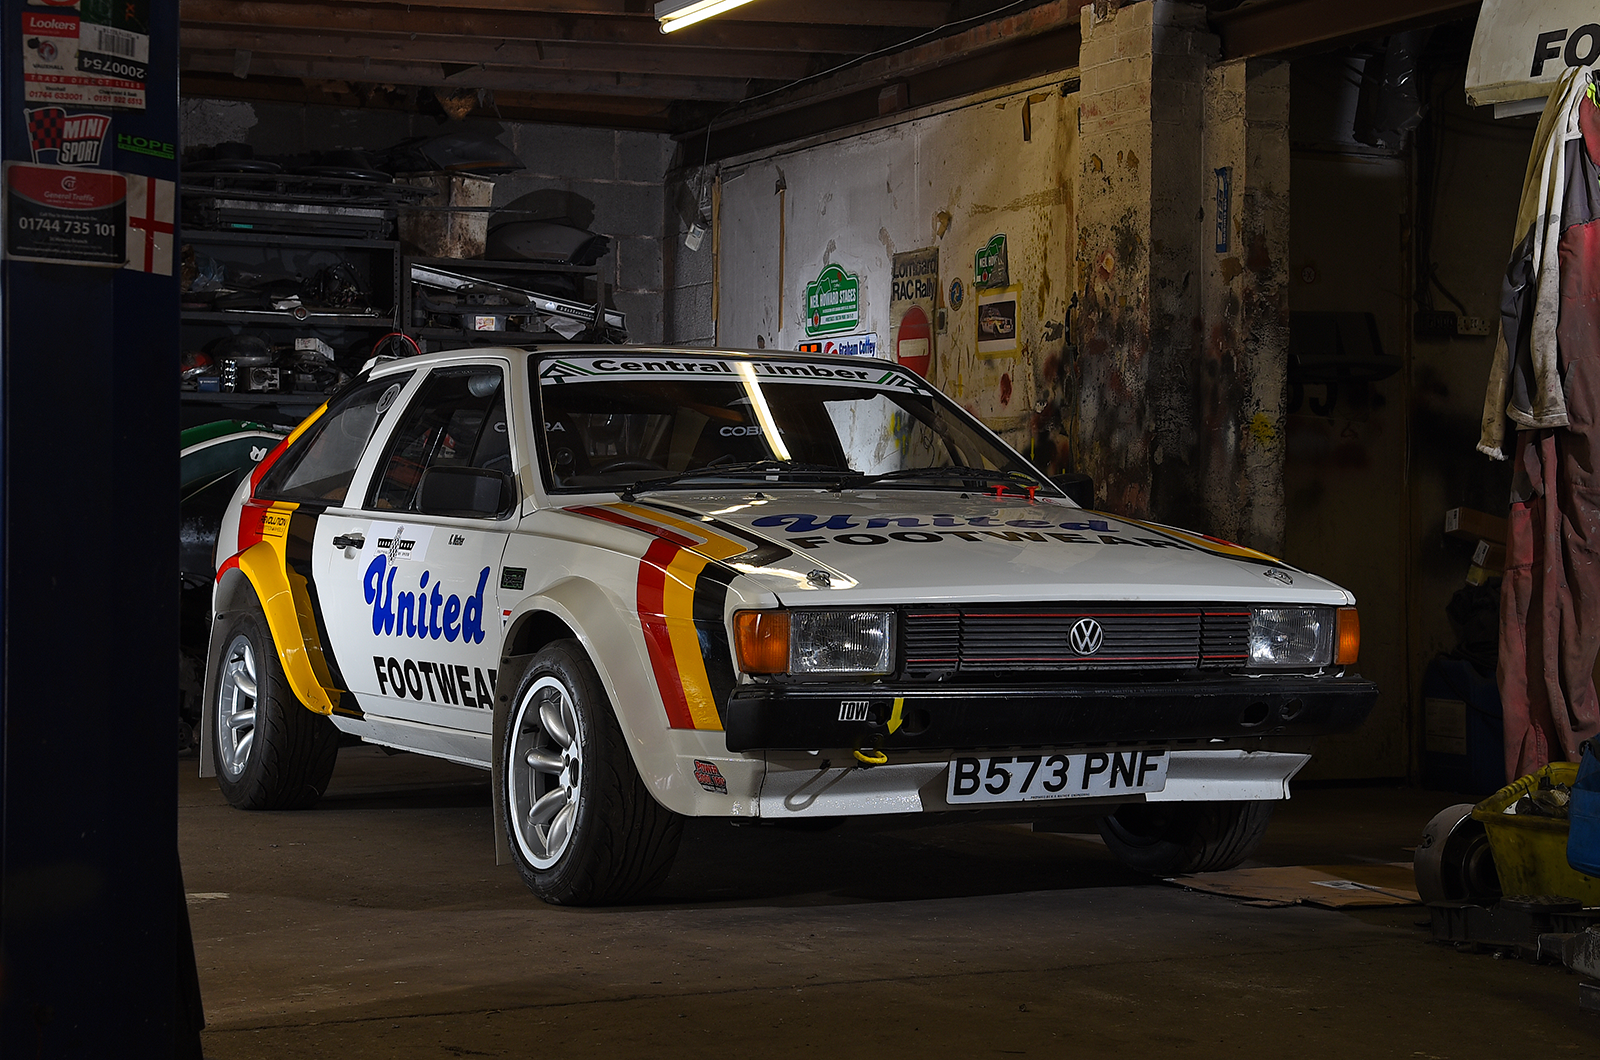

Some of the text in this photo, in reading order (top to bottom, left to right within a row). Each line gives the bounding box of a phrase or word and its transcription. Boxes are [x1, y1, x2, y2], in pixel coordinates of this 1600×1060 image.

[29, 16, 77, 31] Lookers
[30, 74, 141, 89] TRADE DIRECT LINES
[29, 91, 83, 100] 01744 633001
[63, 118, 105, 139] MINI
[60, 140, 100, 163] SPORT
[117, 133, 175, 153] HOPE
[44, 191, 95, 202] General Traffic
[18, 216, 117, 237] 01744 735 101
[892, 256, 937, 280] Lombard
[839, 287, 857, 304] STAGES
[892, 279, 914, 302] RAC
[915, 277, 936, 301] Rally
[838, 338, 876, 356] Graham Coffey
[592, 360, 732, 373] Central
[751, 513, 1122, 533] United
[786, 531, 1195, 552] FOOTWEAR
[363, 554, 491, 645] United
[840, 701, 870, 721] TOW
[952, 749, 1166, 796] B573 PNF
